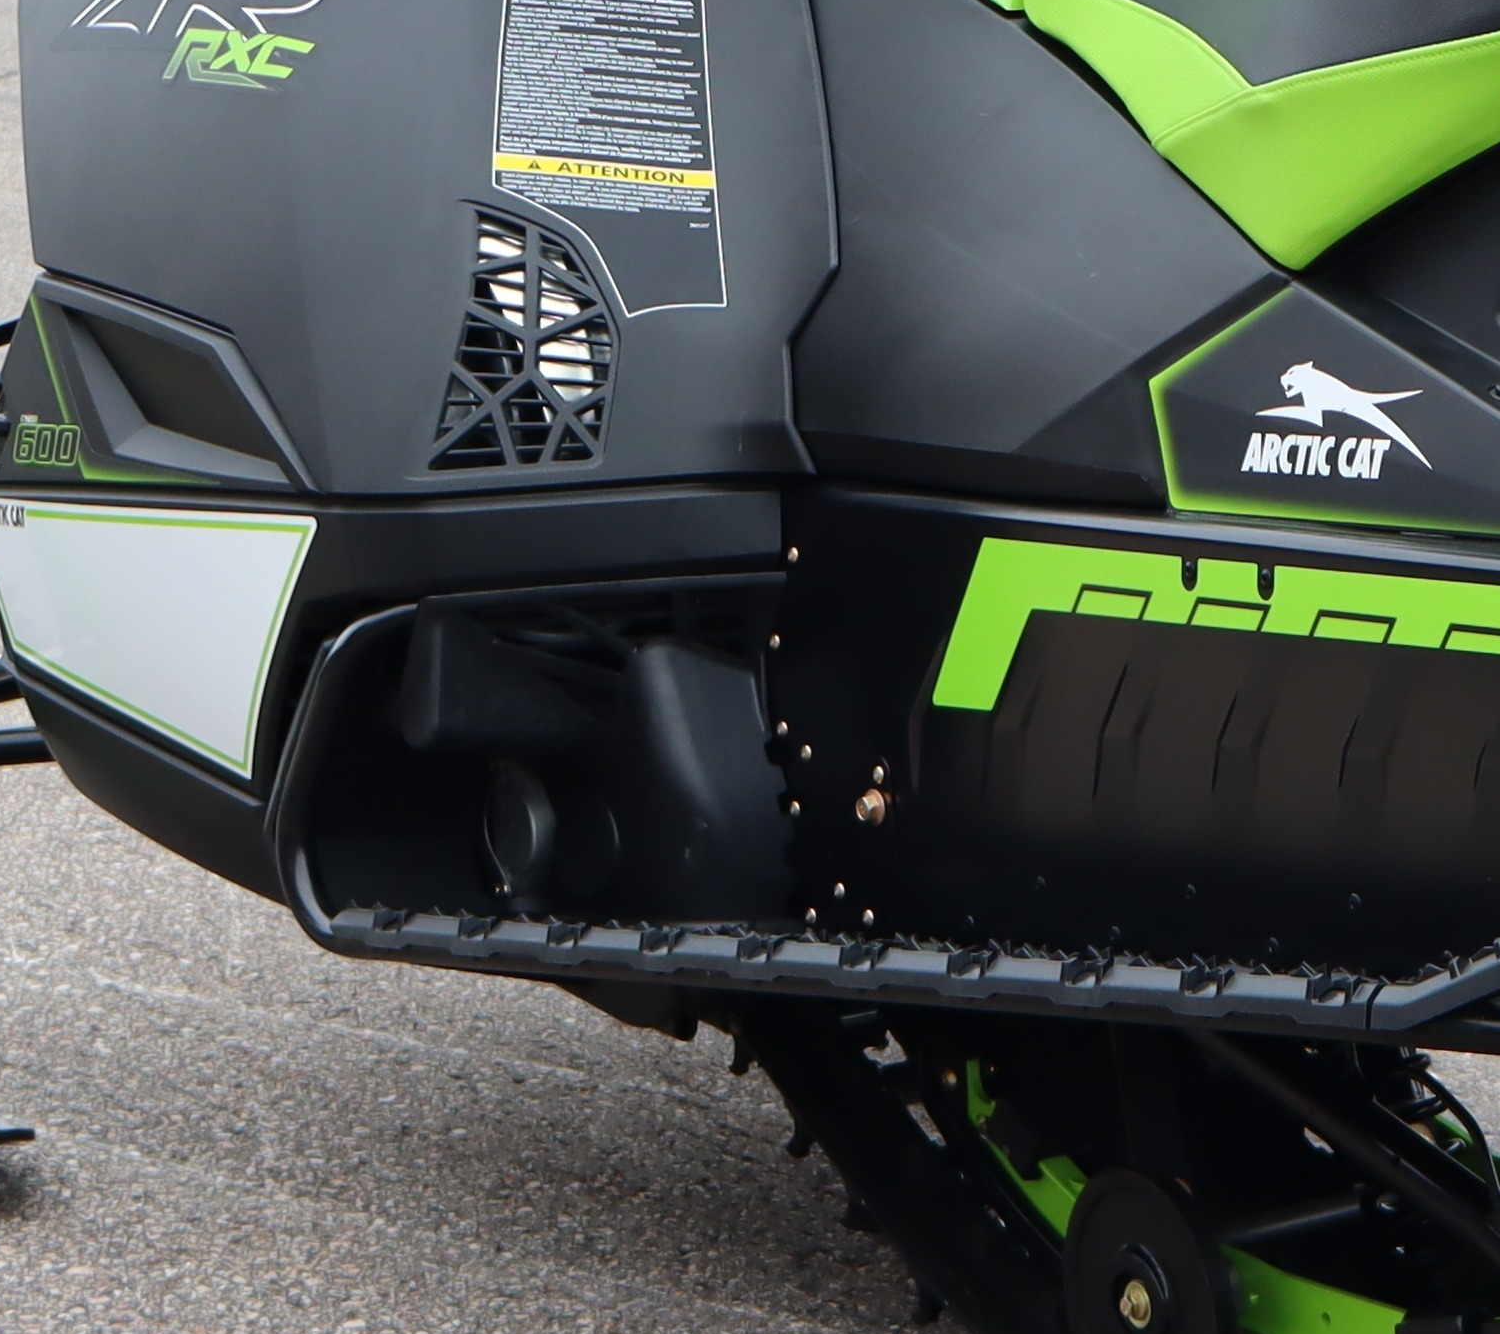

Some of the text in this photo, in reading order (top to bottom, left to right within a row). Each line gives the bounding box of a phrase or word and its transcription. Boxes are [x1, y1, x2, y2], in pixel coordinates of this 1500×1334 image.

[161, 28, 315, 91] RXC
[557, 162, 685, 184] ATTENTION
[13, 423, 80, 466] 600
[1241, 432, 1391, 480] ARCTIC CAT
[10, 506, 25, 527] CAT
